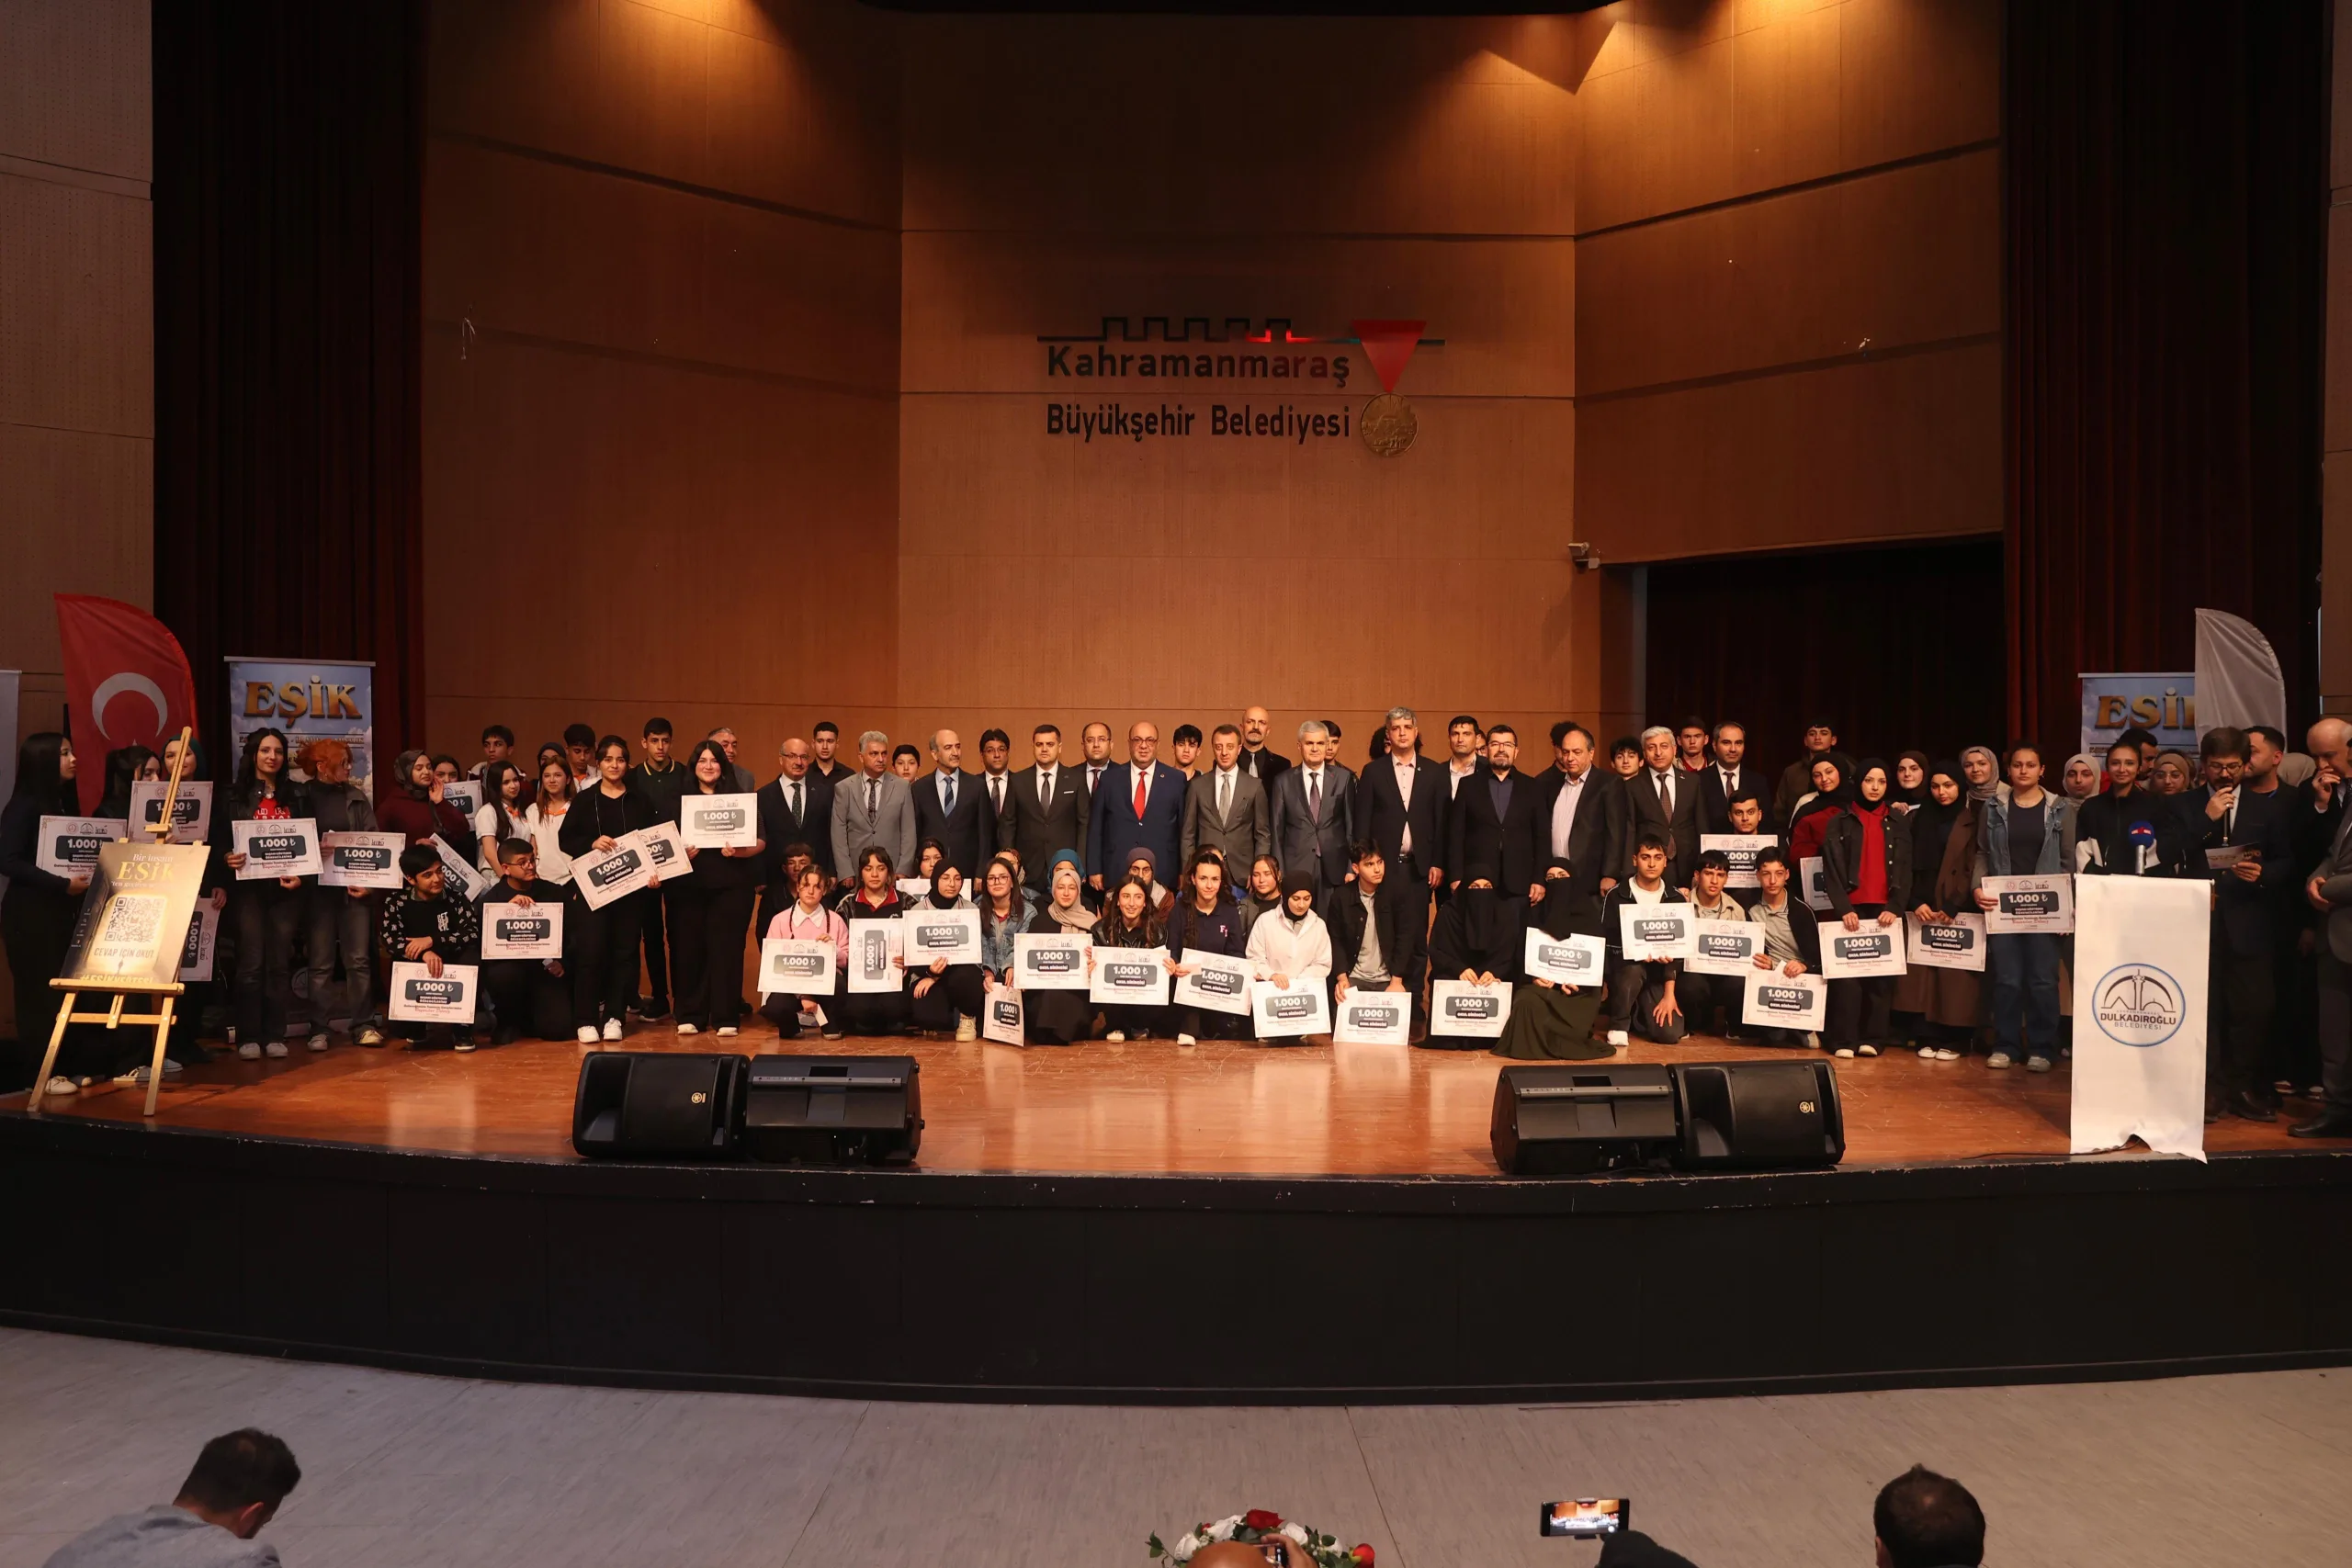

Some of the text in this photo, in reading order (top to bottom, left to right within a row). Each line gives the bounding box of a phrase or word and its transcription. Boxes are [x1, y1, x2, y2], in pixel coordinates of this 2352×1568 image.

[1047, 345, 1350, 387] Kahramanmaraş
[1046, 403, 1350, 445] Büyükşehir Belediyesi
[243, 675, 362, 728] EŞİK
[156, 802, 185, 810] 1.00
[68, 839, 96, 848] 1.000
[258, 838, 288, 847] 1.000
[344, 849, 373, 858] 1.000
[597, 859, 622, 875] 1.000
[441, 865, 456, 881] 000
[2008, 894, 2039, 903] 1.000
[506, 921, 534, 930] 1.000
[1641, 922, 1668, 930] 1.000
[189, 921, 199, 950] 1.000
[925, 928, 952, 936] 1.000
[1930, 928, 1957, 938] 1.000
[1708, 937, 1736, 947] 1.000
[1843, 938, 1873, 948] 1.000
[94, 948, 117, 957] CEVAP
[1036, 951, 1063, 960] 1.000
[1548, 948, 1575, 958] 1.000
[1113, 966, 1141, 975] 1.000
[1201, 970, 1227, 982] 1.000
[415, 983, 445, 992] 1.000
[1768, 989, 1796, 998] 1.000
[1274, 998, 1300, 1007] 1.000
[1455, 999, 1482, 1007] 1.000
[1000, 1004, 1014, 1014] 1.000
